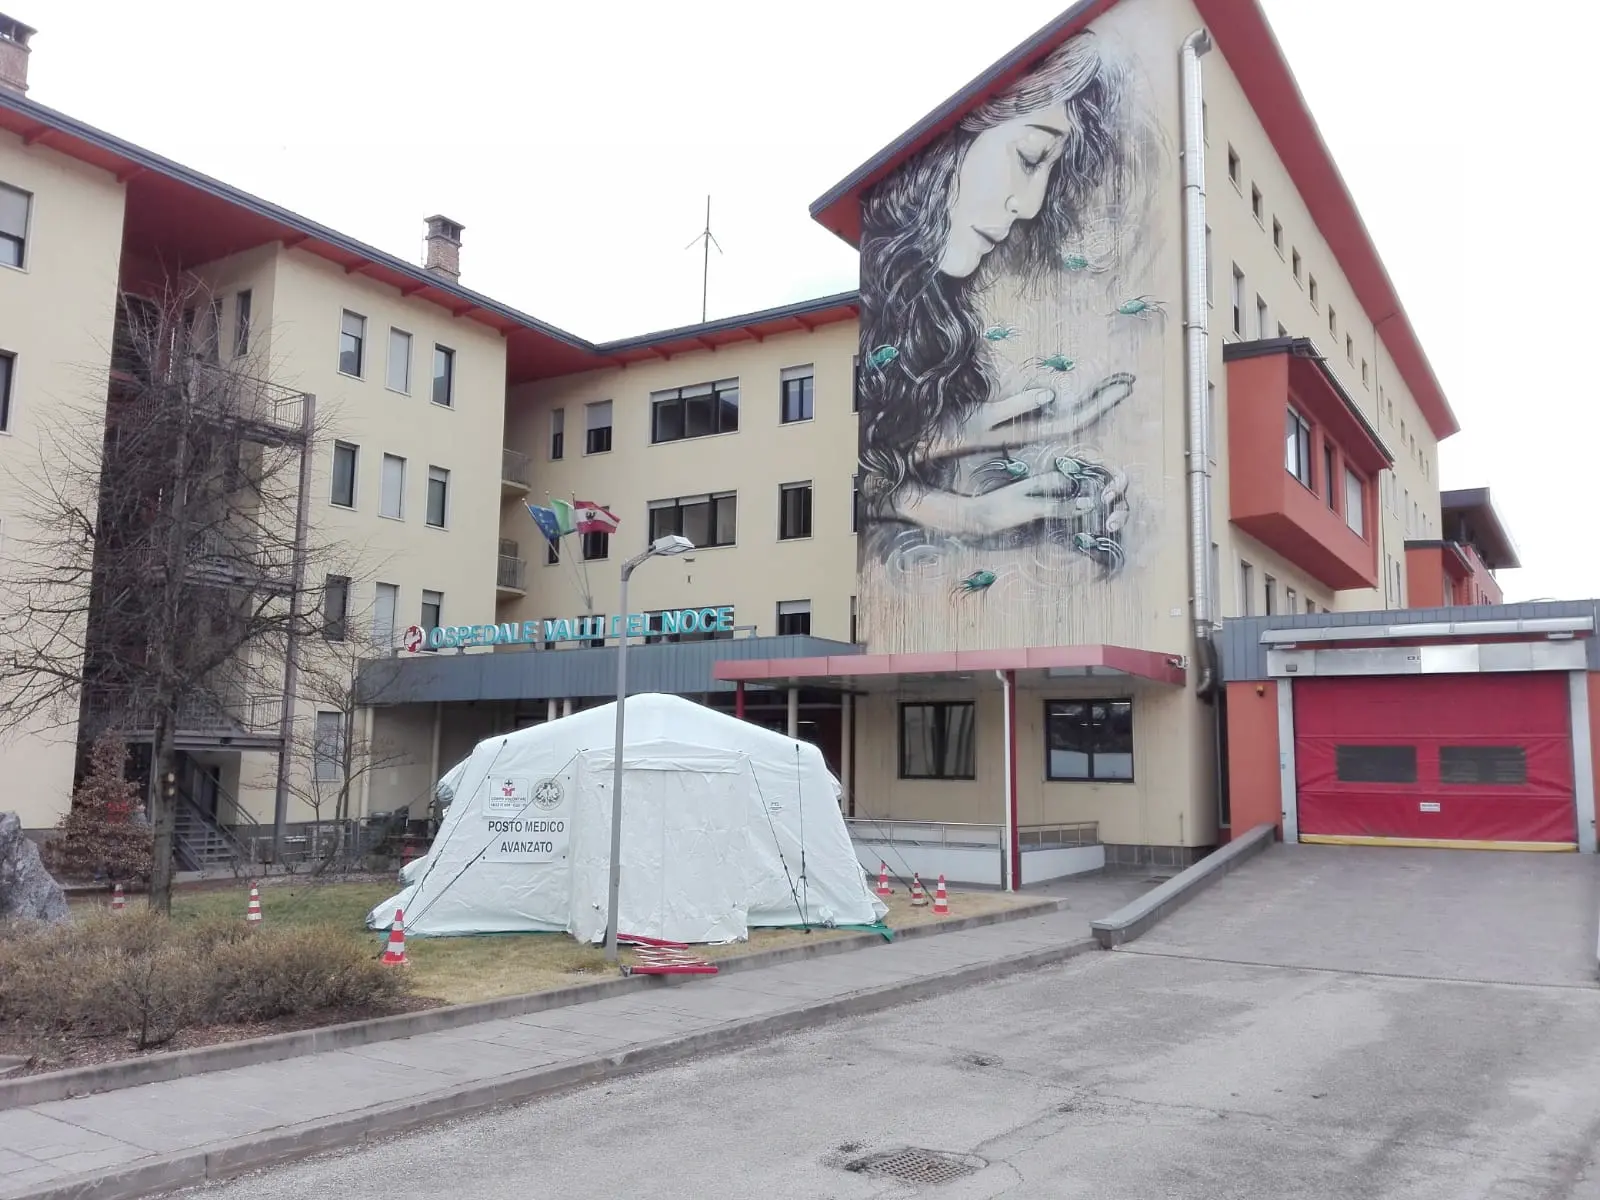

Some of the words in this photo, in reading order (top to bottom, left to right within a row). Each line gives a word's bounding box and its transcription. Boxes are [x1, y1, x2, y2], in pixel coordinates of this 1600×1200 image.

[429, 620, 538, 649] OSPEDALE
[544, 616, 605, 640] VALLI
[660, 606, 735, 634] NOCE
[488, 820, 523, 833] POSTO
[524, 820, 565, 833] MEDICO
[500, 841, 553, 853] AVANZATO
